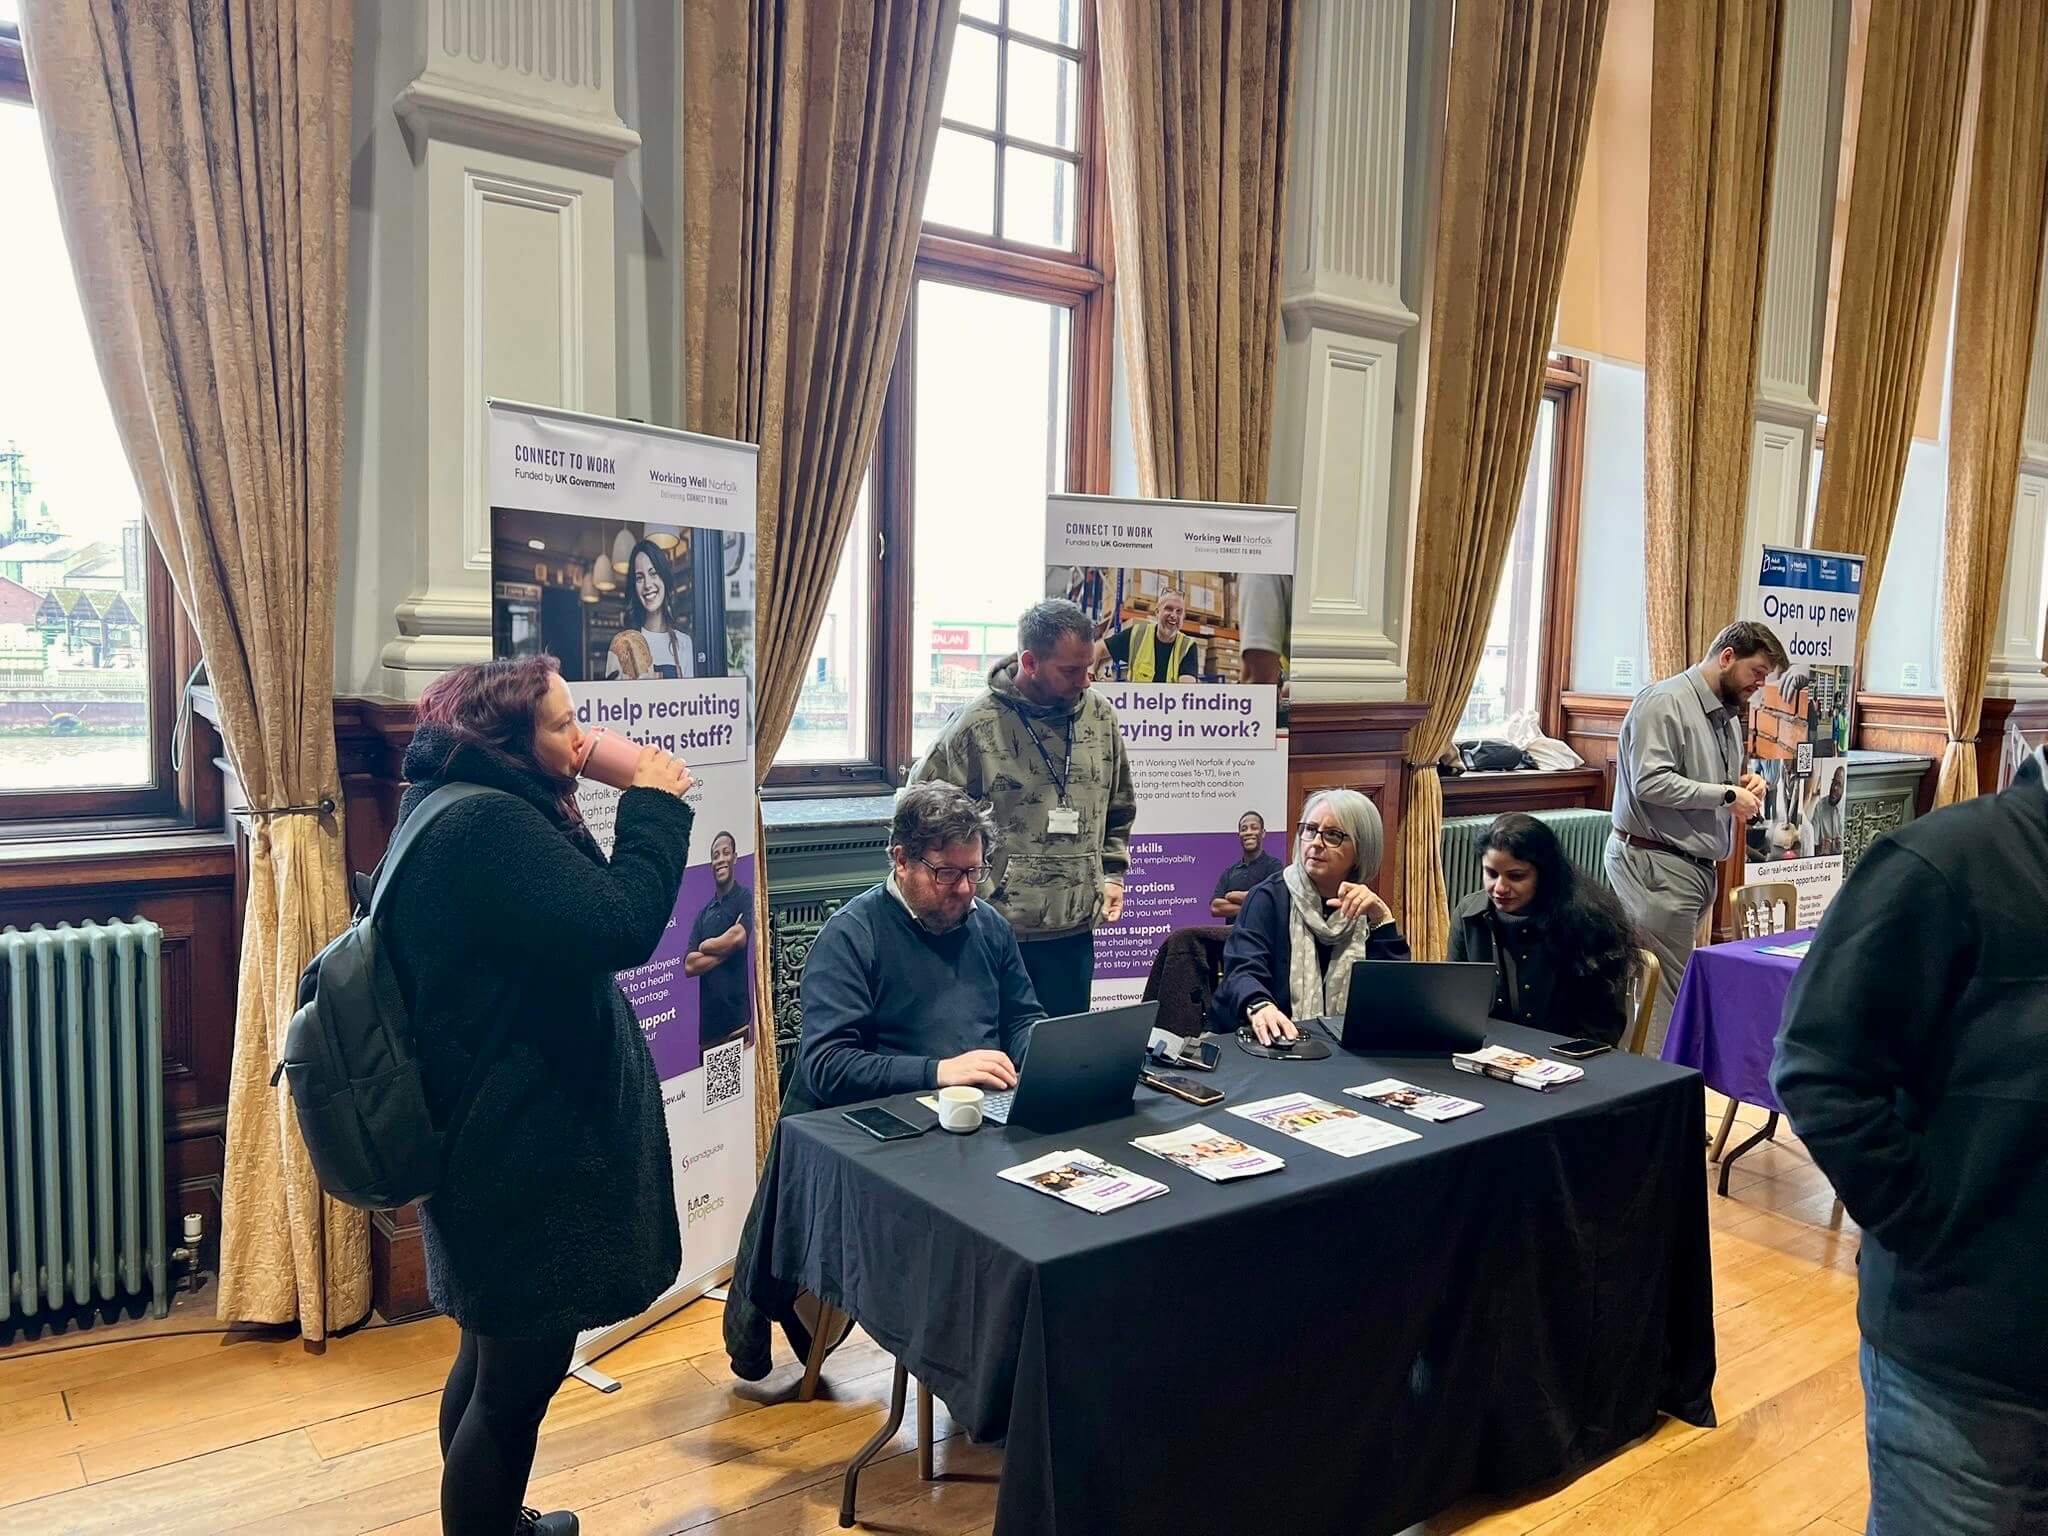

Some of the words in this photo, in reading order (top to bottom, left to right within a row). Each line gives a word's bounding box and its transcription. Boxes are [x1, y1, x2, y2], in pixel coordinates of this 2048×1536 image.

[515, 445, 565, 467] CONNECT
[570, 453, 582, 470] TO
[587, 456, 615, 474] WORK
[515, 468, 543, 480] Funded
[545, 472, 554, 484] by
[555, 474, 567, 484] UK
[570, 476, 615, 490] Government
[650, 470, 687, 487] Working
[689, 476, 707, 488] Well
[708, 478, 737, 491] Norfolk
[1066, 522, 1108, 536] CONNECT
[1112, 525, 1123, 536] TO
[1127, 526, 1152, 538] WORK
[1065, 538, 1090, 546] Funded
[1091, 539, 1099, 547] by
[1112, 540, 1152, 549] Government
[1184, 532, 1221, 544] Working
[1223, 534, 1241, 542] Well
[1243, 535, 1272, 544] Norfolk
[1764, 595, 1803, 624] Open
[1809, 605, 1825, 627] up
[1830, 607, 1856, 622] new
[1789, 631, 1832, 656] doors!
[597, 697, 642, 726] help
[649, 693, 740, 719] recruiting
[1134, 692, 1176, 714] help
[1182, 693, 1251, 715] finding
[680, 724, 732, 749] staff?
[1119, 720, 1172, 742] aying
[1178, 720, 1195, 737] in
[1201, 720, 1261, 737] work?
[1145, 759, 1176, 768] Working
[1178, 758, 1194, 766] Well
[1195, 758, 1223, 766] Norfolk
[1232, 759, 1255, 767] you're
[1139, 769, 1146, 777] in
[1141, 780, 1180, 789] long-term
[1181, 780, 1206, 788] health
[1207, 780, 1244, 788] condition
[579, 788, 610, 801] Norfolk
[1154, 791, 1170, 799] and
[1201, 790, 1216, 798] find
[1217, 790, 1236, 798] work
[1136, 842, 1163, 853] skills
[1144, 854, 1196, 865] employability
[1126, 867, 1147, 875] skills.
[1758, 866, 1770, 876] Gain
[1771, 863, 1798, 874] real-world
[1799, 862, 1812, 872] skills
[1813, 861, 1824, 870] and
[1795, 874, 1831, 886] opportunities
[1135, 881, 1175, 894] options
[1137, 898, 1156, 906] local
[1157, 896, 1198, 906] employers
[1121, 909, 1134, 919] job
[1136, 910, 1151, 919] you
[1152, 908, 1172, 916] want
[1092, 927, 1127, 936] nuous
[1129, 923, 1171, 937] support
[1108, 938, 1152, 948] challenges
[1115, 950, 1130, 958] you
[1131, 948, 1147, 956] and
[1149, 949, 1159, 957] yo
[636, 957, 680, 975] employees
[1113, 959, 1130, 969] stay
[1132, 959, 1140, 967] in
[630, 983, 638, 992] to
[640, 981, 646, 989] a
[648, 971, 673, 986] health
[1092, 992, 1143, 1002] onnecttowor
[639, 1007, 676, 1031] upport
[688, 1193, 709, 1212] future
[688, 1196, 724, 1228] projects
